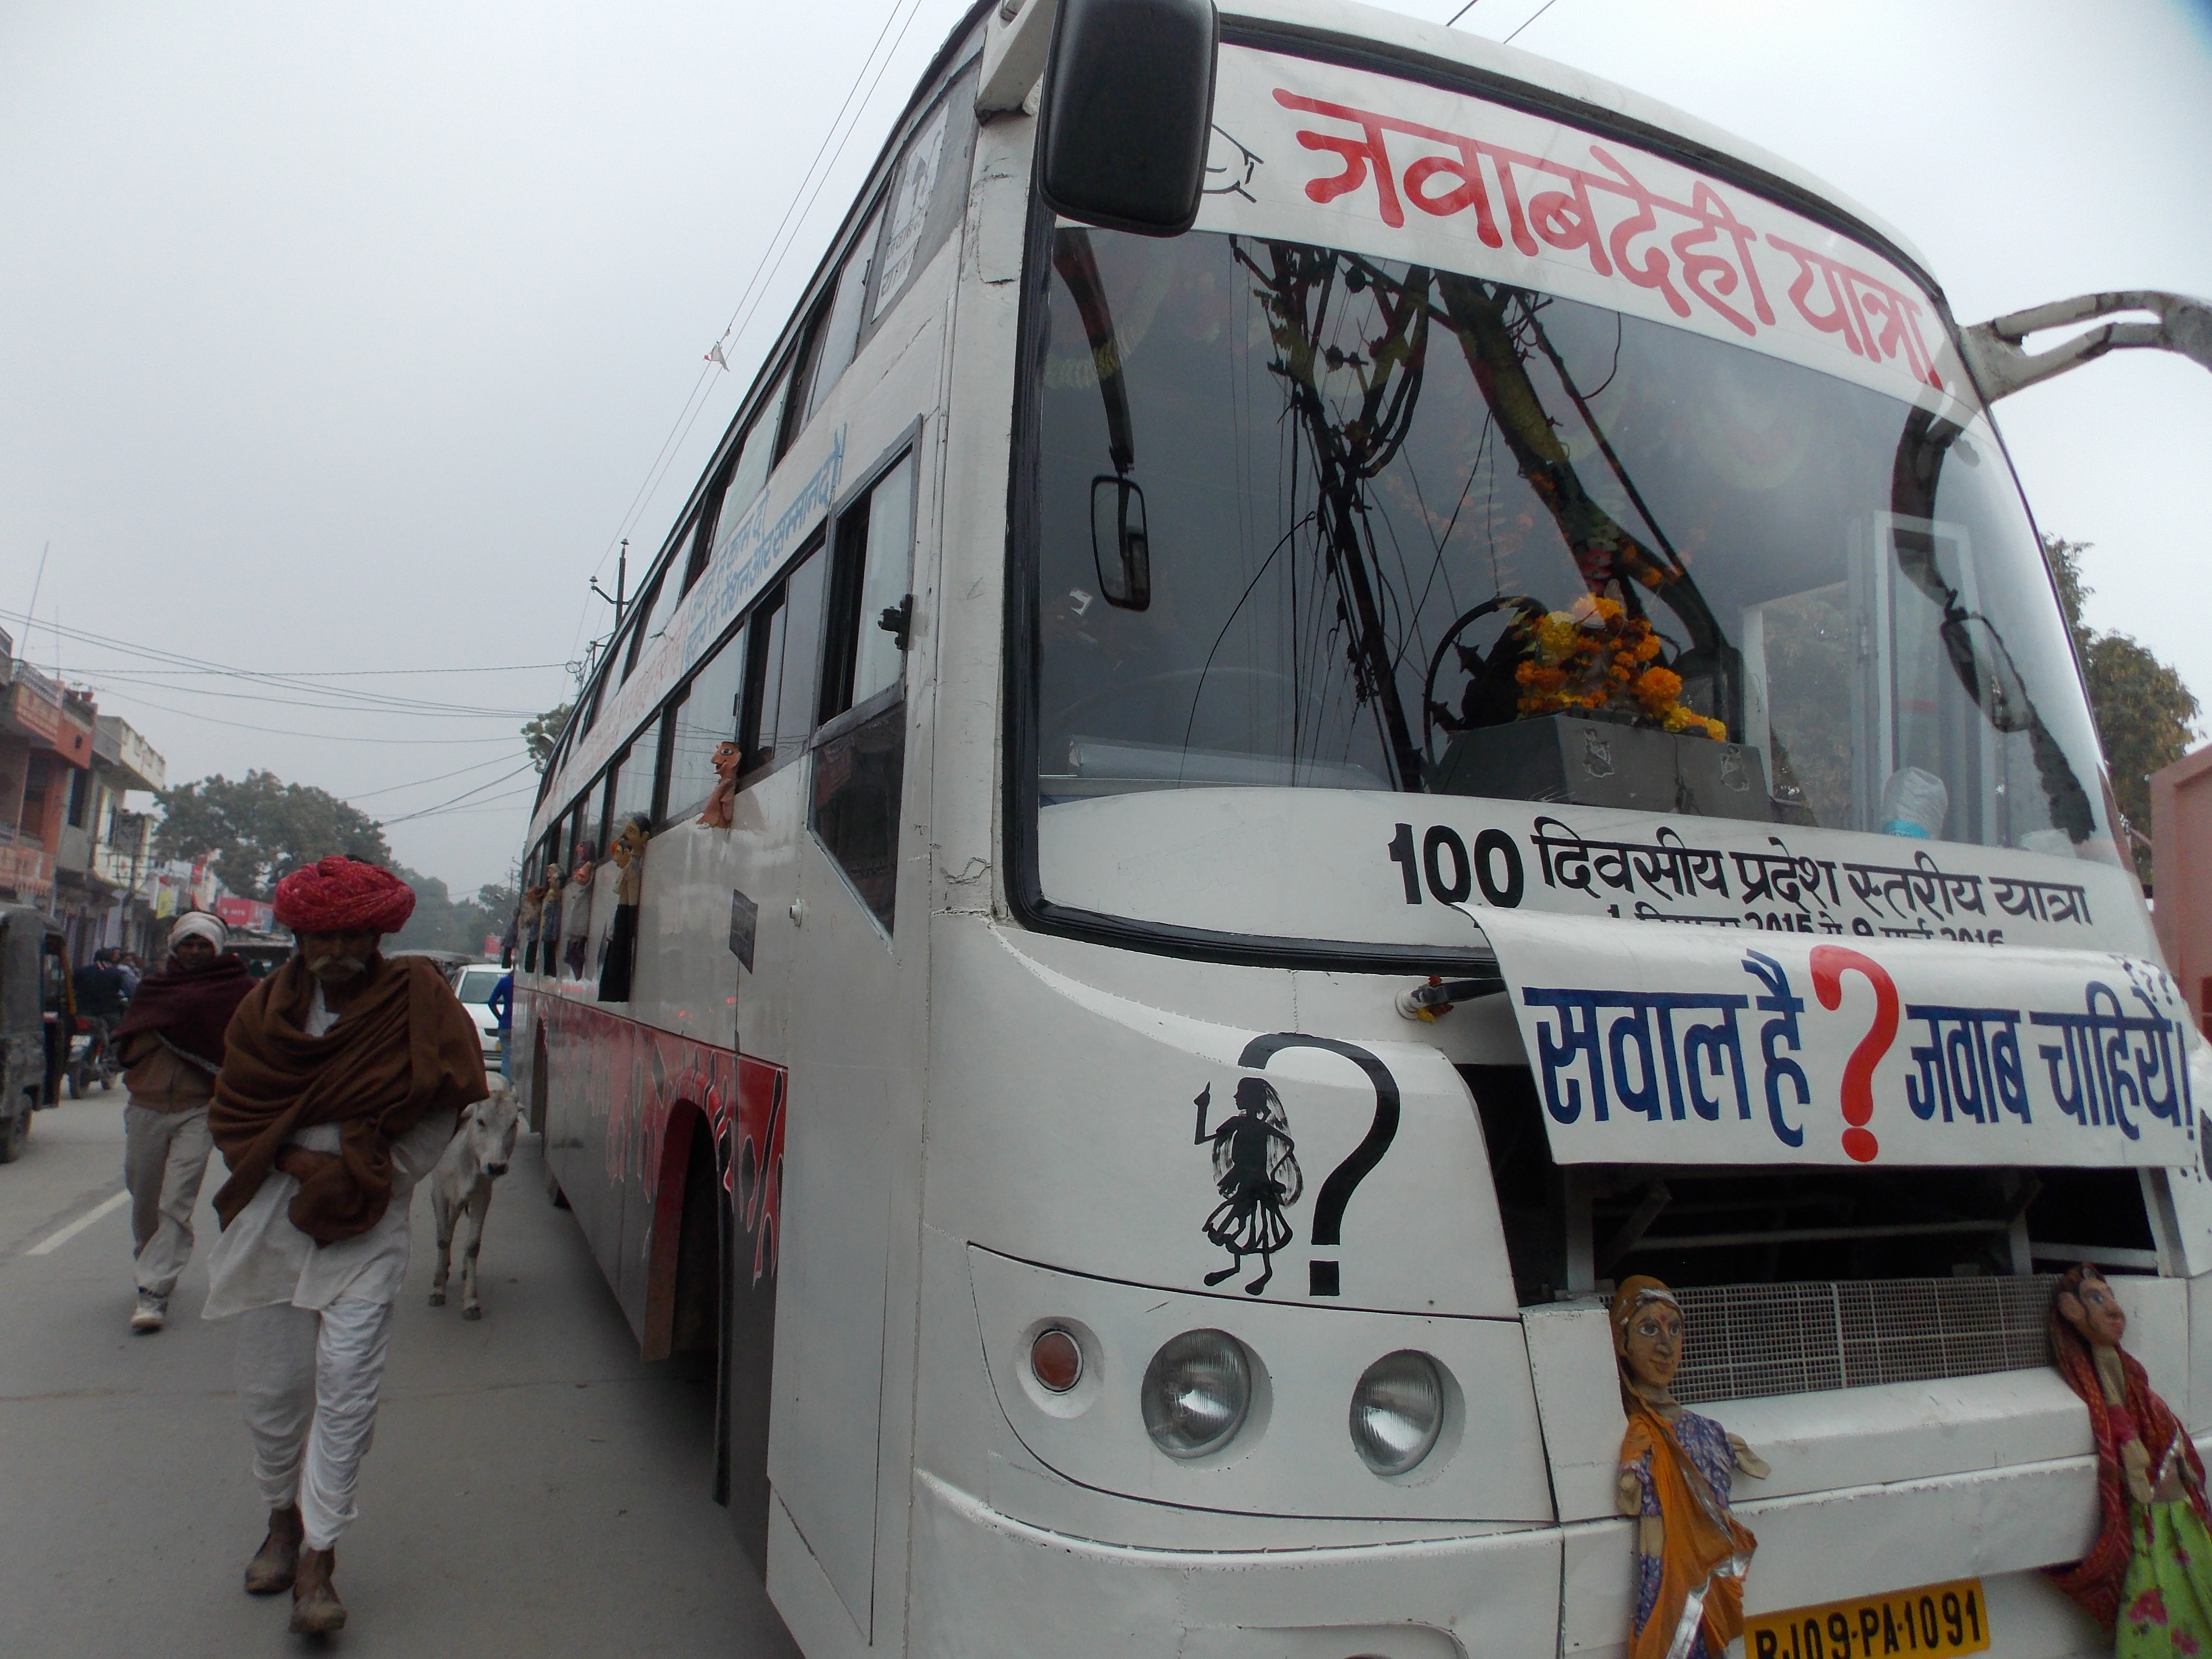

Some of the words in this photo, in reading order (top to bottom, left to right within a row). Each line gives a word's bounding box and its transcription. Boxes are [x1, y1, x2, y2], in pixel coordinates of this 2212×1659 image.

[1272, 87, 1774, 336] जवाबदेही
[1766, 232, 1944, 391] यात्रा
[1387, 823, 1524, 908] 100
[1529, 816, 1730, 902] दिवसीय
[1728, 836, 1841, 913] प्रदेश
[1842, 850, 1987, 922] स्तरीय
[1988, 876, 2092, 926] यात्रा
[1523, 986, 1752, 1125] सवाल
[1904, 1003, 2032, 1125] जवाब
